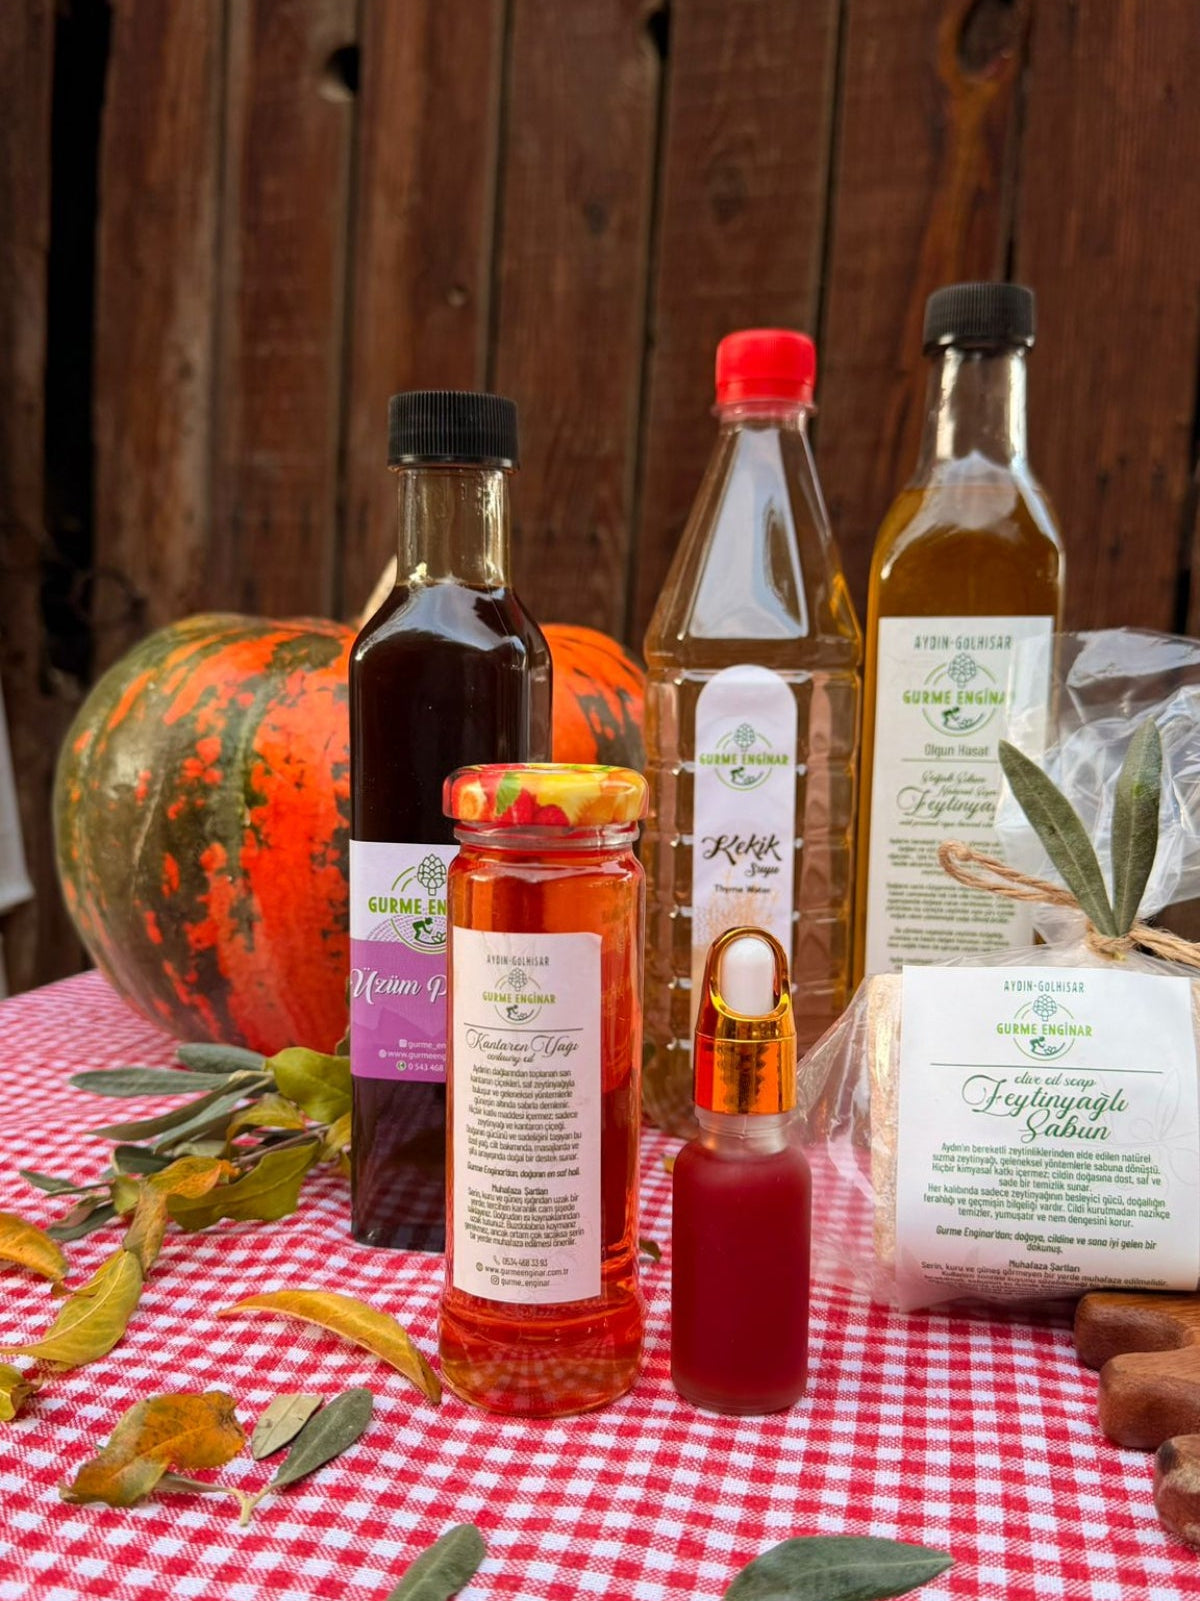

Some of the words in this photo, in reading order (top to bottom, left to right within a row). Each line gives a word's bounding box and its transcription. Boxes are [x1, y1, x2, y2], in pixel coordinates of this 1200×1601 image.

[902, 690, 950, 705] GURME
[956, 688, 1005, 705] ENGİNA
[699, 753, 736, 765] GURME
[924, 743, 954, 758] Olgun
[958, 744, 988, 756] Hasat
[701, 833, 781, 865] Kekik
[744, 862, 779, 878] Suyu
[368, 896, 422, 914] GURME
[350, 967, 422, 1005] Üzüm
[482, 991, 512, 1003] GURME
[515, 990, 556, 1004] ENGİNAR
[996, 1022, 1037, 1034] GURME
[1041, 1020, 1092, 1036] ENGİNAR
[1014, 1071, 1042, 1085] olive
[1044, 1073, 1063, 1086] oil
[1064, 1078, 1097, 1092] soap
[962, 1074, 1129, 1121] Zeytinyağlı
[1017, 1108, 1111, 1143] Sabun
[971, 1143, 1006, 1153] bereketli
[1076, 1150, 1093, 1158] elde
[1095, 1151, 1119, 1160] edilen
[1121, 1152, 1150, 1162] natürel
[1000, 1156, 1041, 1168] geleneksel
[1044, 1159, 1091, 1171] yöntemlerle
[1093, 1162, 1122, 1171] sabuna
[931, 1163, 954, 1174] Hiçbir
[956, 1164, 991, 1176] kimyasal
[1051, 1170, 1073, 1179] cildin
[1075, 1172, 1111, 1183] doğasına
[1114, 1174, 1133, 1184] dost,
[928, 1183, 941, 1192] Her
[980, 1186, 1008, 1196] sadece
[1065, 1191, 1099, 1203] besleyici
[998, 1178, 1017, 1186] sade
[1019, 1179, 1030, 1187] bir
[1032, 1180, 1063, 1189] temizlik
[1066, 1183, 1091, 1191] sunar.
[1067, 1202, 1084, 1211] Cildi
[1086, 1203, 1135, 1214] kurutmadan
[1067, 1214, 1106, 1226] dengesini
[1108, 1216, 1133, 1225] korur.
[936, 1224, 961, 1235] Gurme
[1047, 1232, 1074, 1243] cildine
[1076, 1235, 1085, 1244] ve
[1087, 1236, 1106, 1246] sana
[1108, 1237, 1119, 1249] iyi
[1121, 1238, 1142, 1251] gelen
[1144, 1239, 1156, 1249] bir
[1008, 1259, 1047, 1270] Muhafaza
